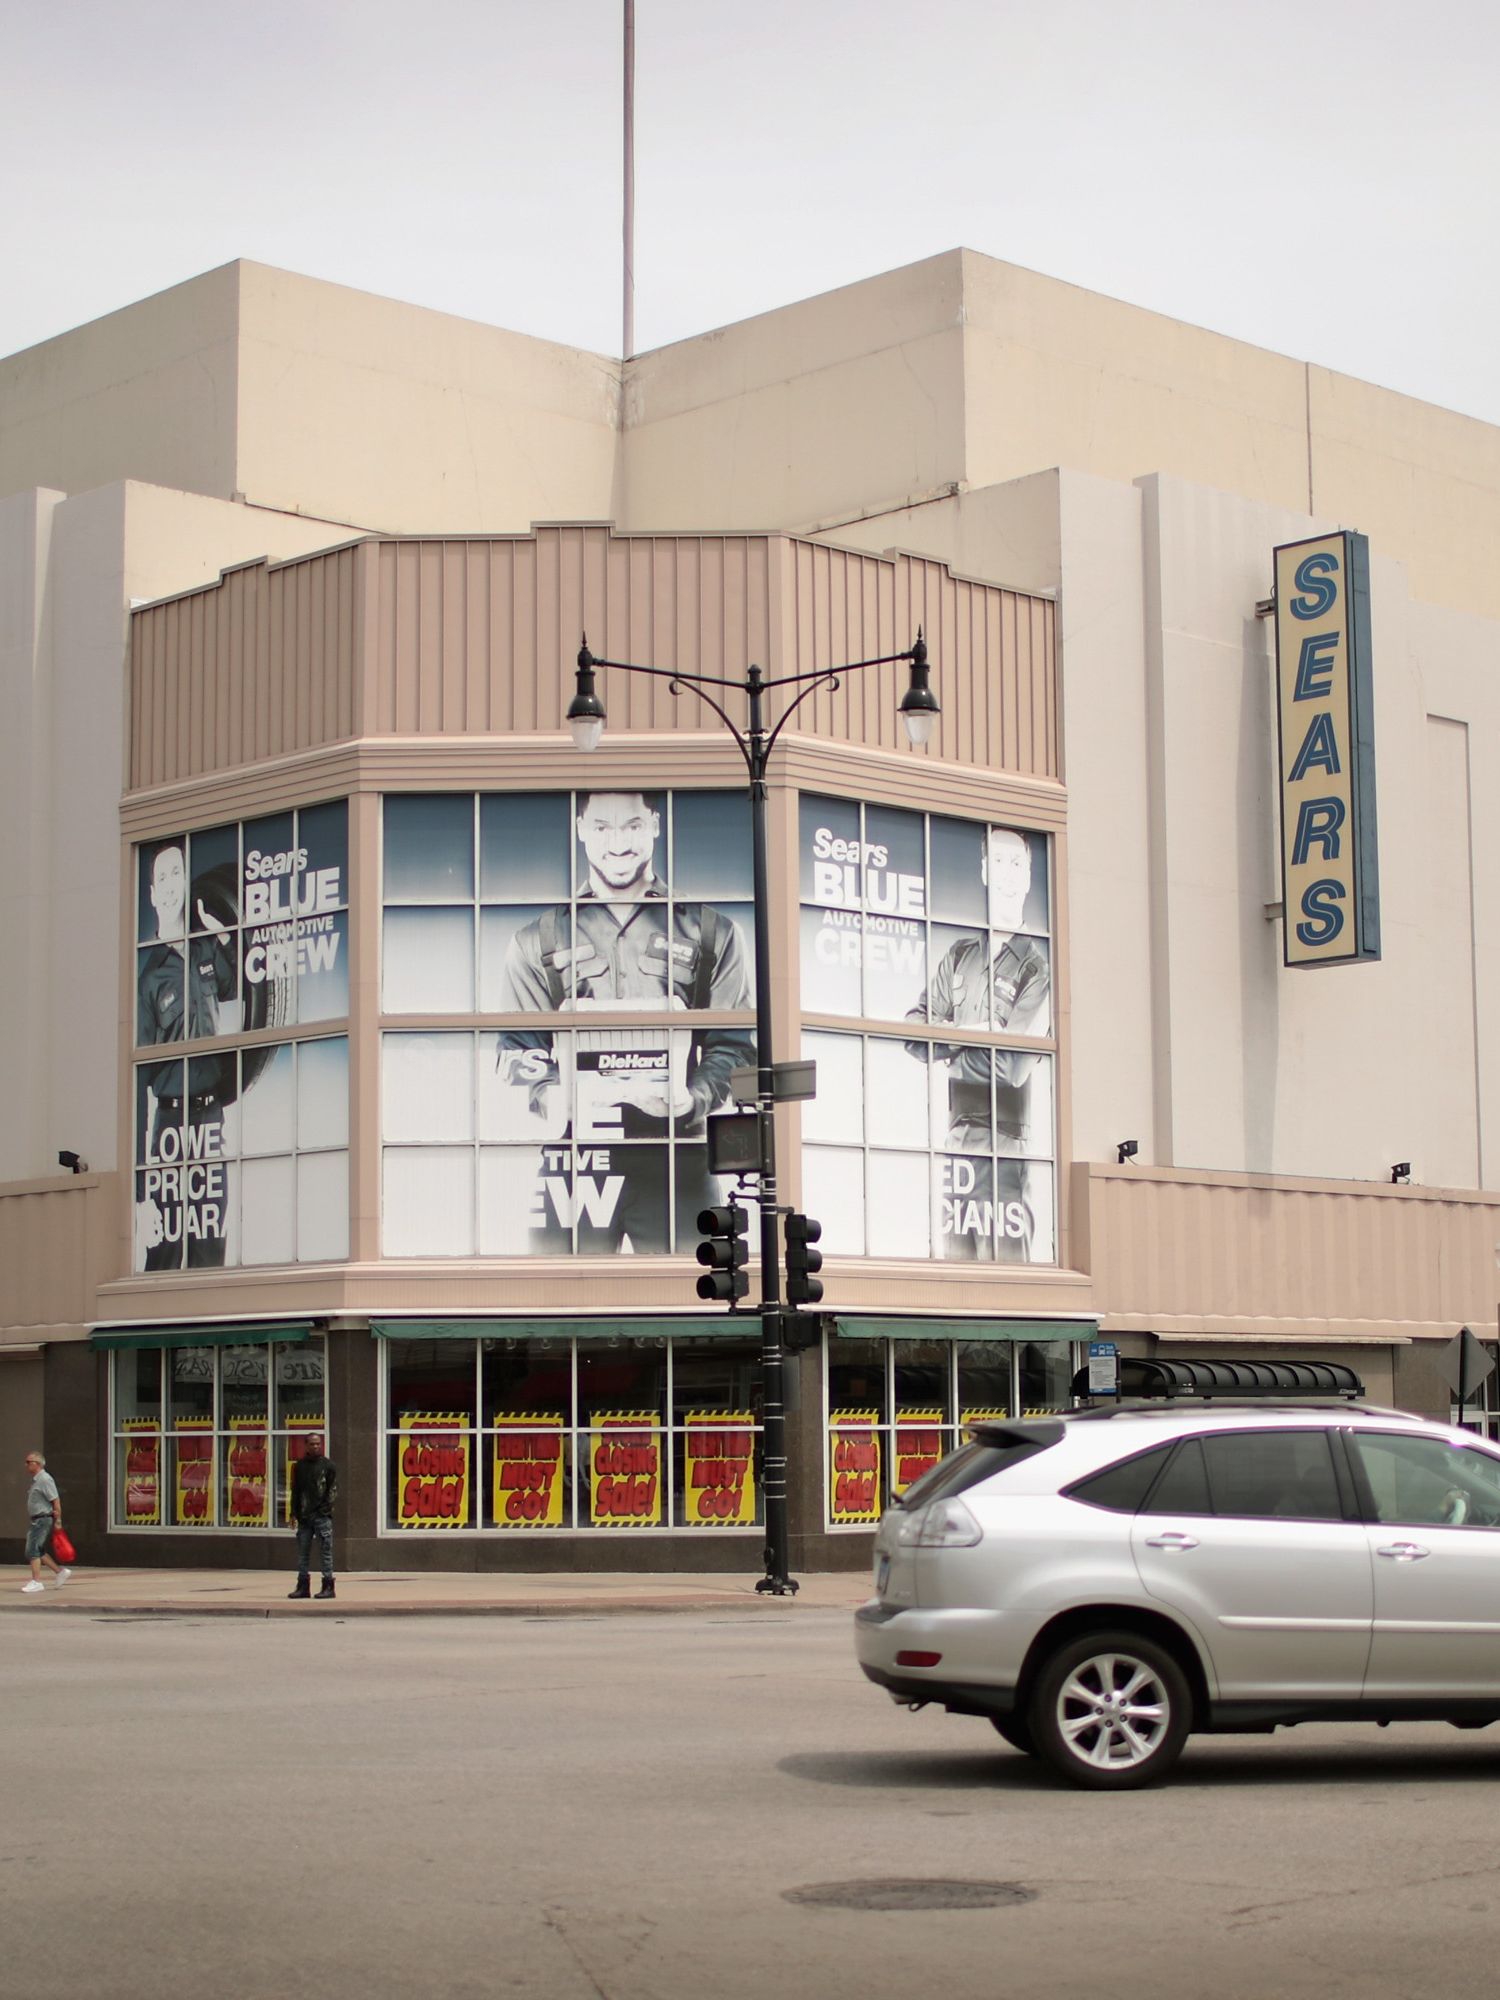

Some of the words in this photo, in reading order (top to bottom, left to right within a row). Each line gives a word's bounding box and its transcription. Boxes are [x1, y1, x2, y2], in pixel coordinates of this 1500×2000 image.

[1287, 553, 1346, 947] SEARS
[245, 848, 308, 880] Sears
[813, 828, 888, 867] Sears
[245, 867, 340, 924] BLUE
[814, 861, 925, 916] BLUE
[252, 915, 334, 944] AUTOMOTIVE
[822, 910, 918, 936] AUTOMOTIVE
[245, 932, 340, 983] CREW
[815, 928, 926, 975] CREW
[598, 1053, 668, 1069] DieHard
[145, 1163, 223, 1203] PRICE
[500, 1462, 556, 1490] MUST
[691, 1460, 748, 1488] MUST
[402, 1477, 464, 1518] Sale!
[505, 1490, 550, 1520] GO!
[595, 1475, 657, 1517] Sale!
[698, 1488, 742, 1518] GO!
